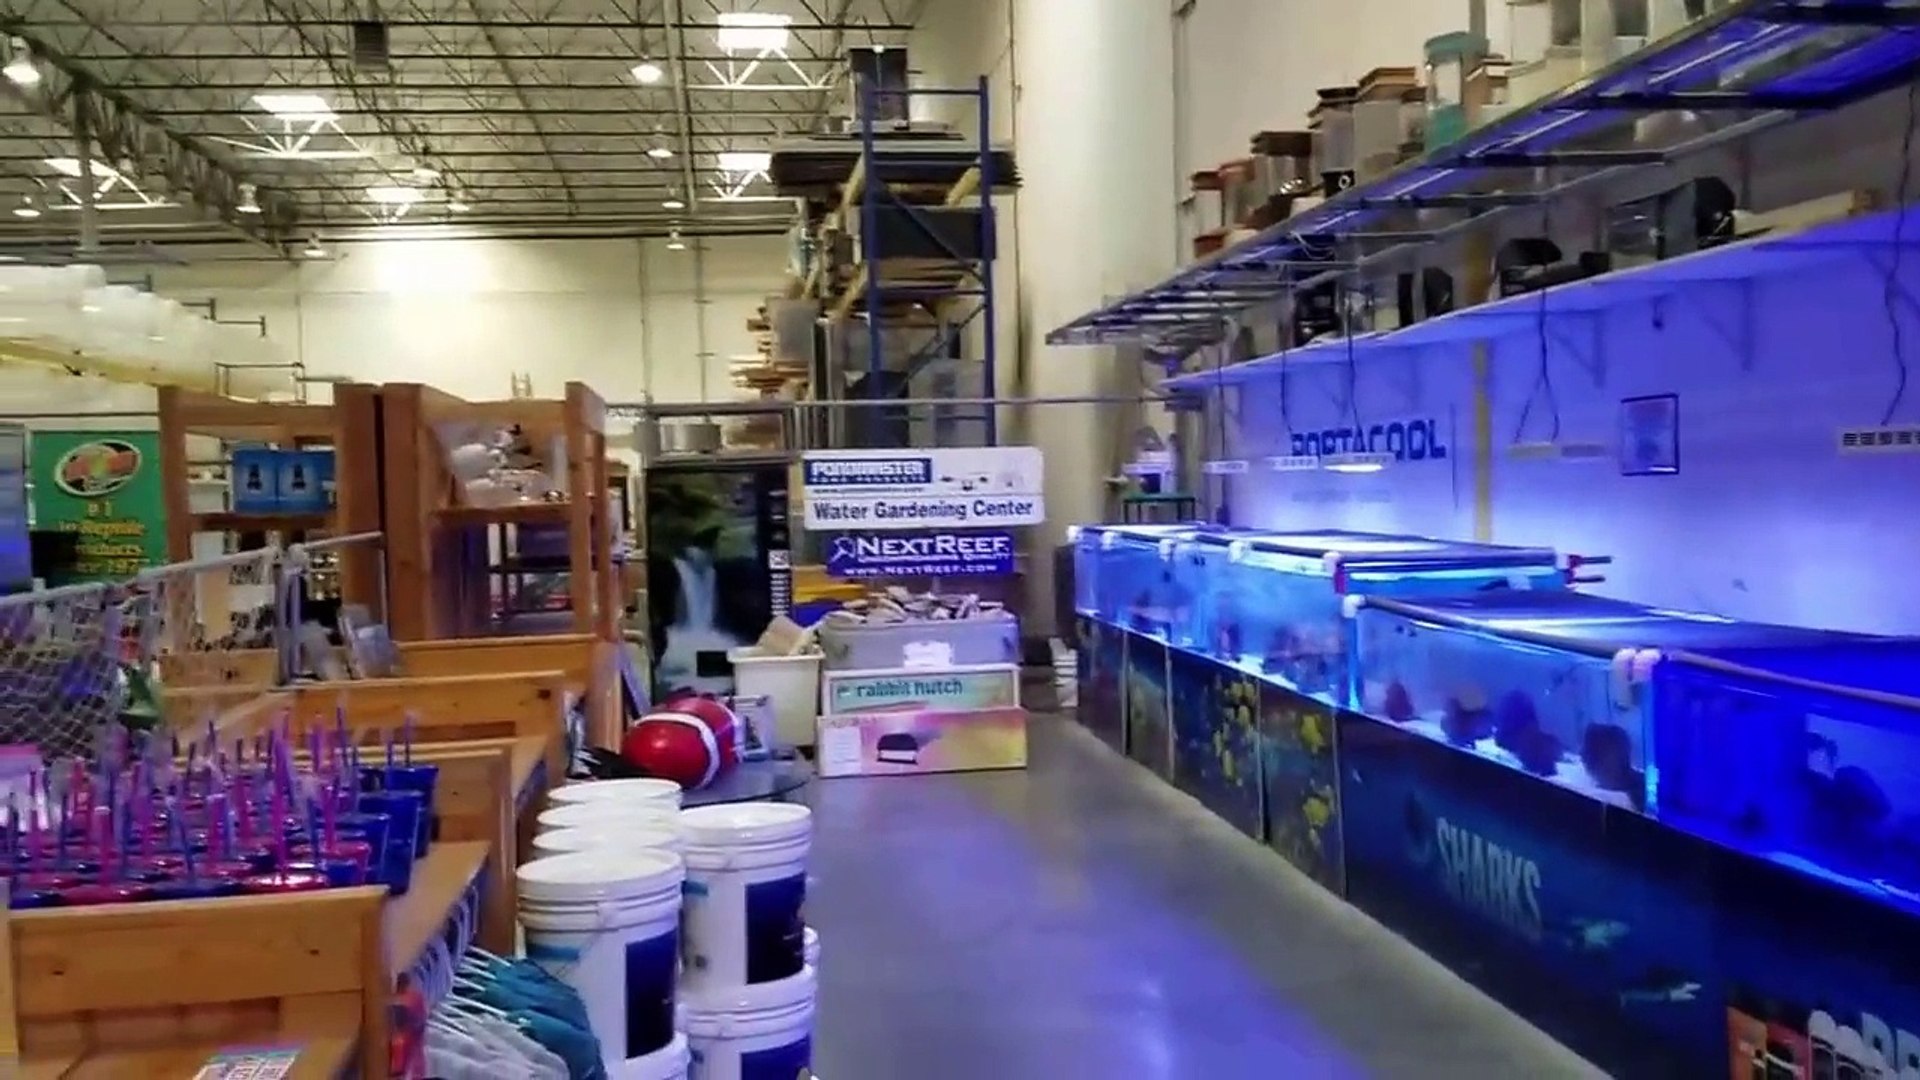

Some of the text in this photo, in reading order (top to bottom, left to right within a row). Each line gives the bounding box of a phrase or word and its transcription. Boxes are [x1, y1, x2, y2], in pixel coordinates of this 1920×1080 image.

[813, 499, 1033, 521] Water Gardening Center
[856, 678, 963, 698] rabbit hutch
[1436, 817, 1542, 942] SHARKS
